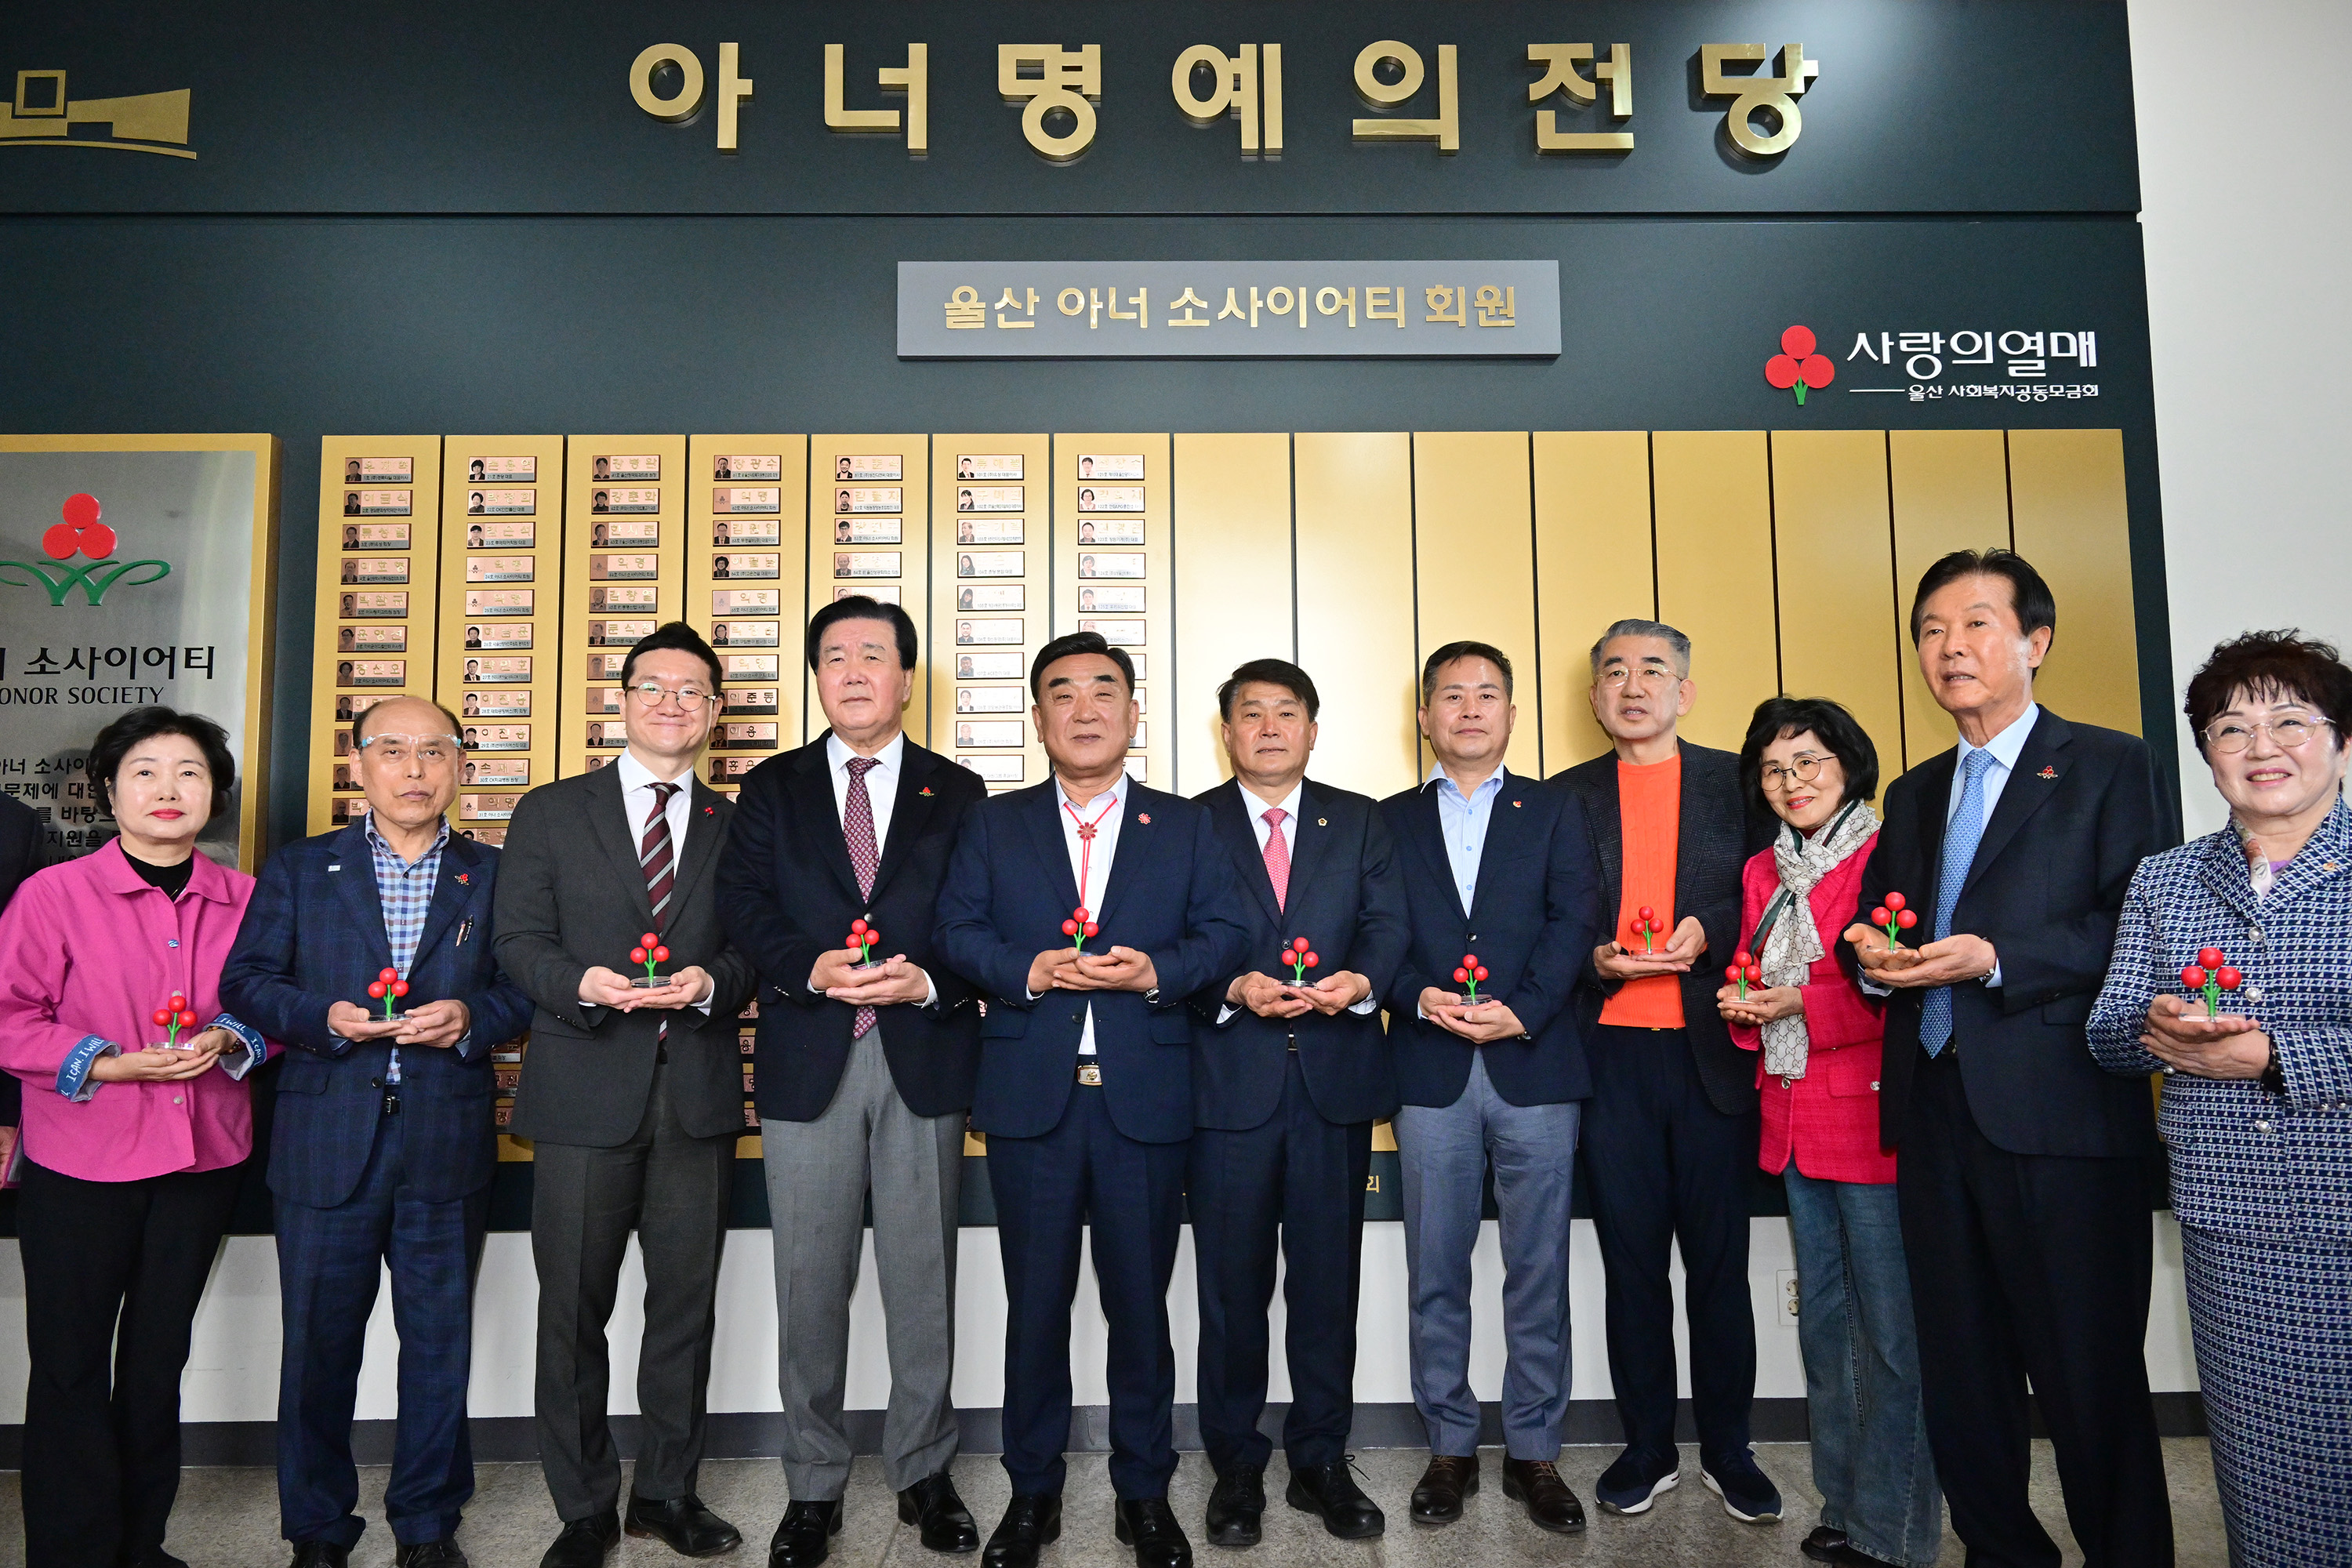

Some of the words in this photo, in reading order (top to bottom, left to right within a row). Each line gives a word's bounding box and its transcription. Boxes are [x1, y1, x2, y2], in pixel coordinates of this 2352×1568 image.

[944, 285, 1040, 329] 울산
[1056, 285, 1149, 329] 아너
[1168, 285, 1406, 329] 소사이어티
[1425, 285, 1515, 329] 회원
[1846, 330, 2098, 380] 사랑의열매
[1907, 384, 1944, 402] 울산
[1947, 383, 2100, 402] 사회복지공동모금회
[24, 646, 215, 681] 소사이어티
[67, 687, 165, 705] SOCIETY
[730, 692, 774, 703] 이준동
[488, 797, 517, 808] 익명
